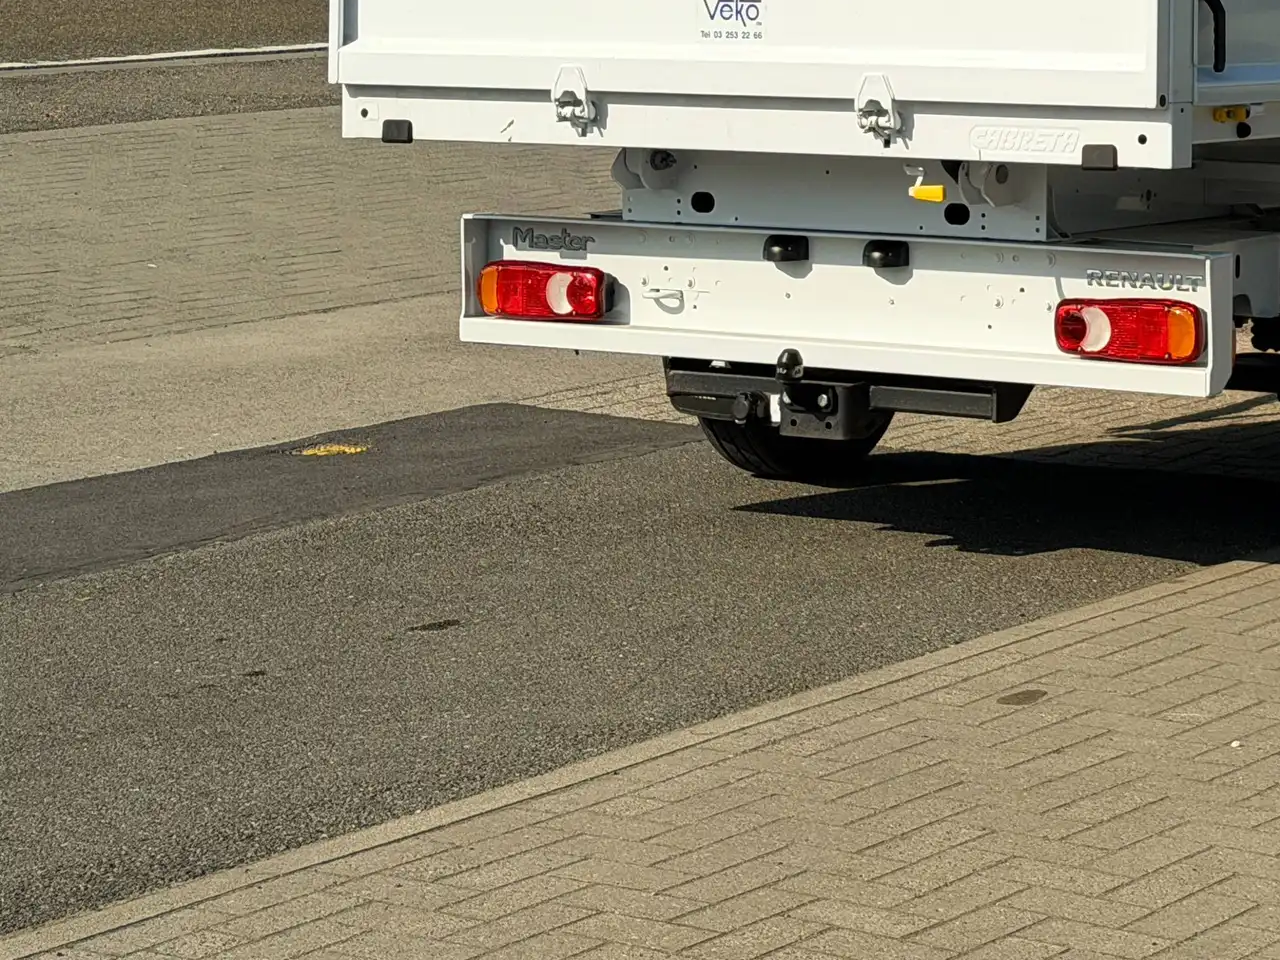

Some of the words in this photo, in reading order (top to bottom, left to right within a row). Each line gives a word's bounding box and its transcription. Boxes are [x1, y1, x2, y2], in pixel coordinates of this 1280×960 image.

[713, 30, 723, 39] 03
[725, 31, 739, 39] 253
[741, 31, 751, 39] 22
[512, 226, 596, 252] Master
[1086, 269, 1203, 292] RENAULT
